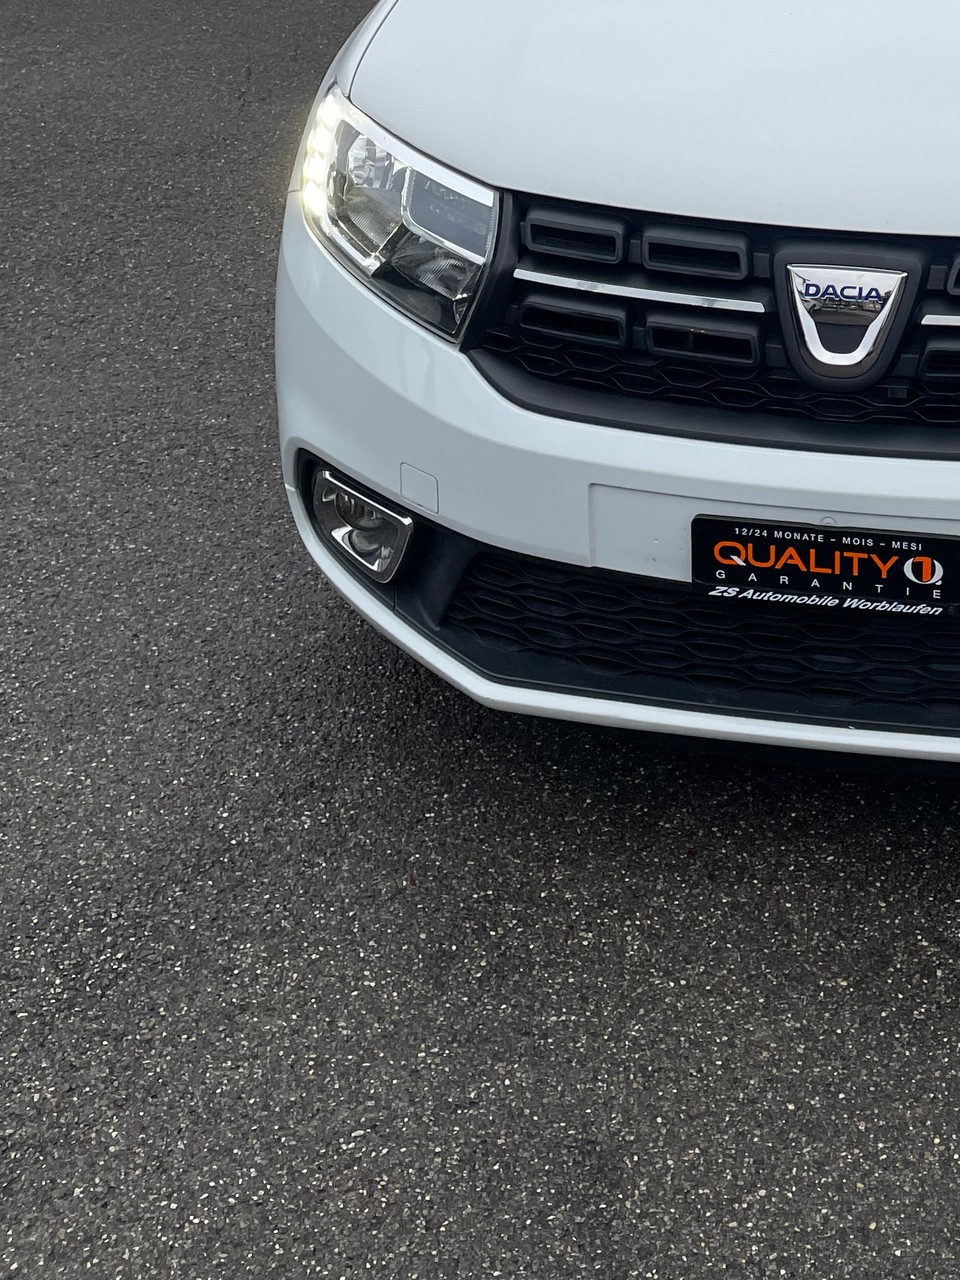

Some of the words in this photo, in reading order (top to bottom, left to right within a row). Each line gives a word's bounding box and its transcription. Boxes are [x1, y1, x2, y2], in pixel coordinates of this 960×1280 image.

[803, 282, 884, 303] DACIA
[734, 527, 768, 538] 12/24
[774, 530, 825, 542] MONATE
[842, 536, 874, 547] MOIS
[891, 541, 923, 551] MESI
[713, 540, 900, 579] QUALITY
[708, 585, 742, 597] ZS
[738, 589, 840, 608] Automobile
[842, 597, 944, 616] Worblaufen
